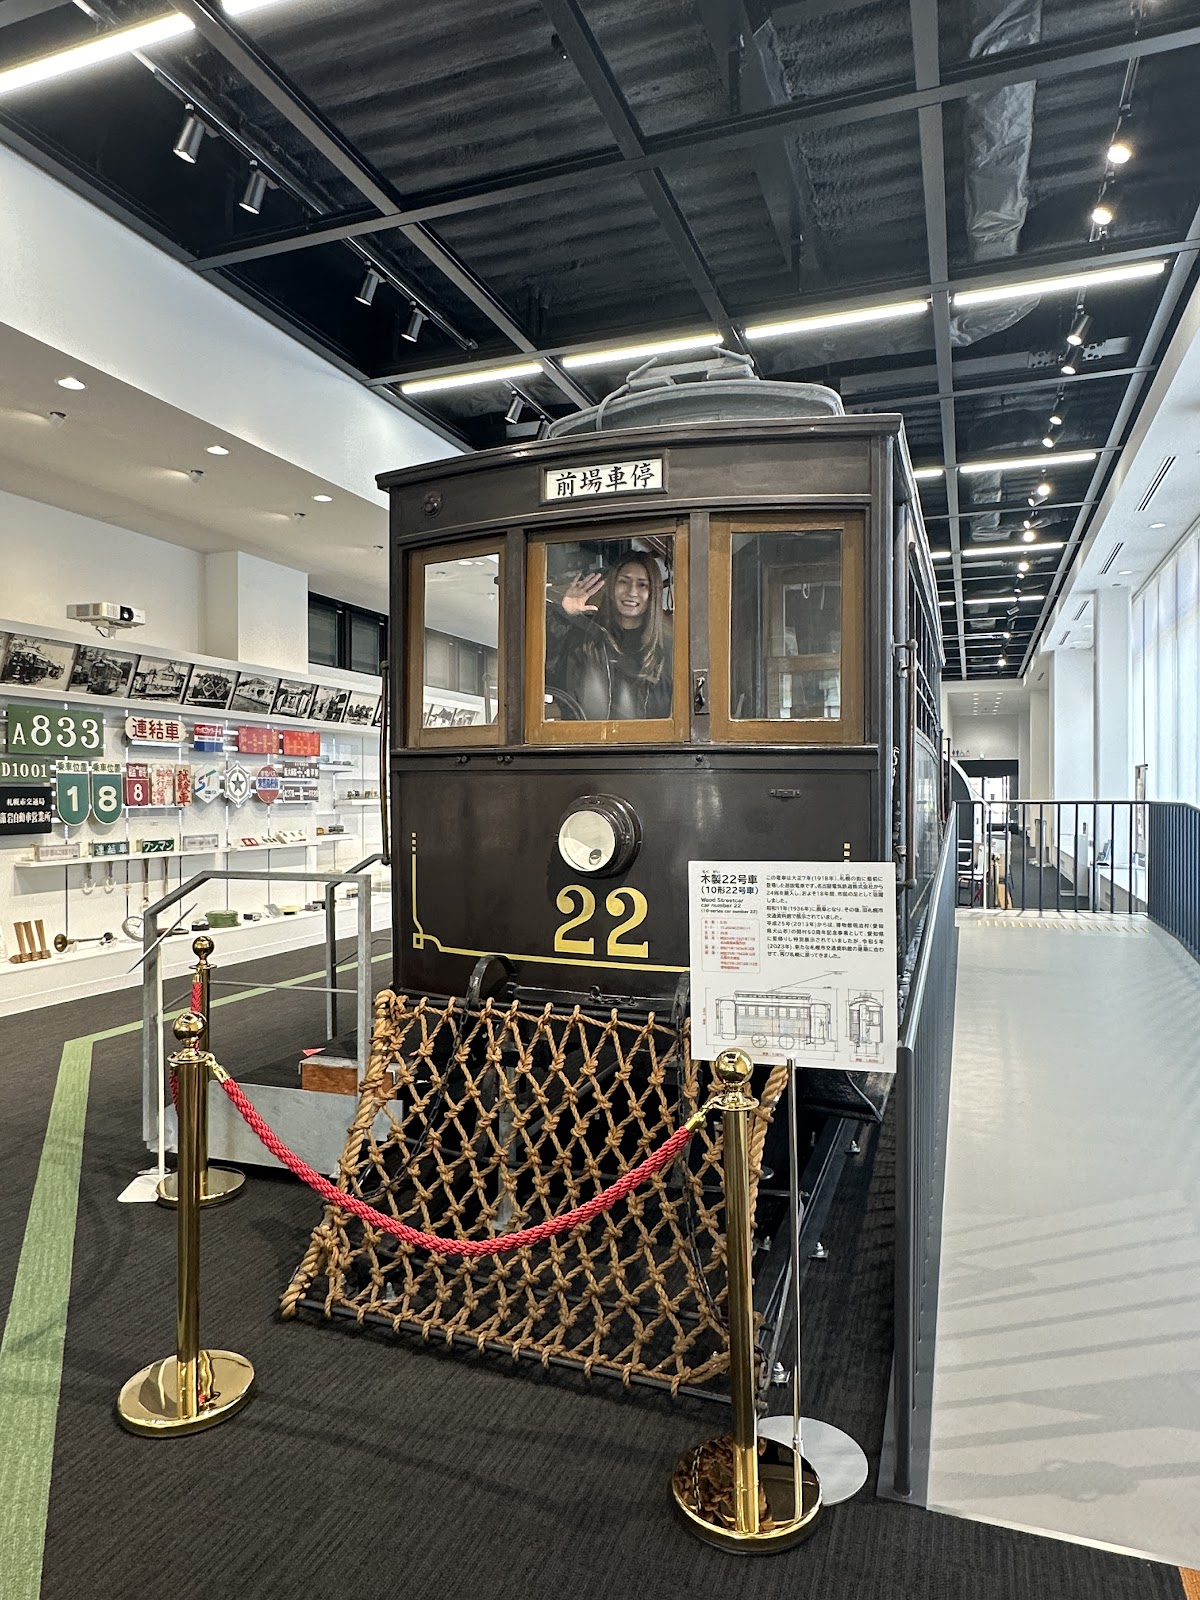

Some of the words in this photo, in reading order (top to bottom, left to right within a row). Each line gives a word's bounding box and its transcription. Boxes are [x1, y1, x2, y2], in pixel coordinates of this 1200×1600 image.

[12, 714, 100, 749] A833
[132, 718, 179, 740] 連結車
[1, 762, 48, 778] D1001
[57, 761, 88, 772] 乗車位置
[92, 761, 121, 773] 乗車位置
[67, 786, 78, 812] 1
[98, 785, 117, 812] 8
[133, 783, 143, 802] 8
[6, 796, 46, 807] 札幌市交通局
[95, 844, 128, 856] 連結車
[142, 840, 174, 852] ワンマン
[700, 874, 758, 884] 木製22号車
[554, 884, 648, 958] 22
